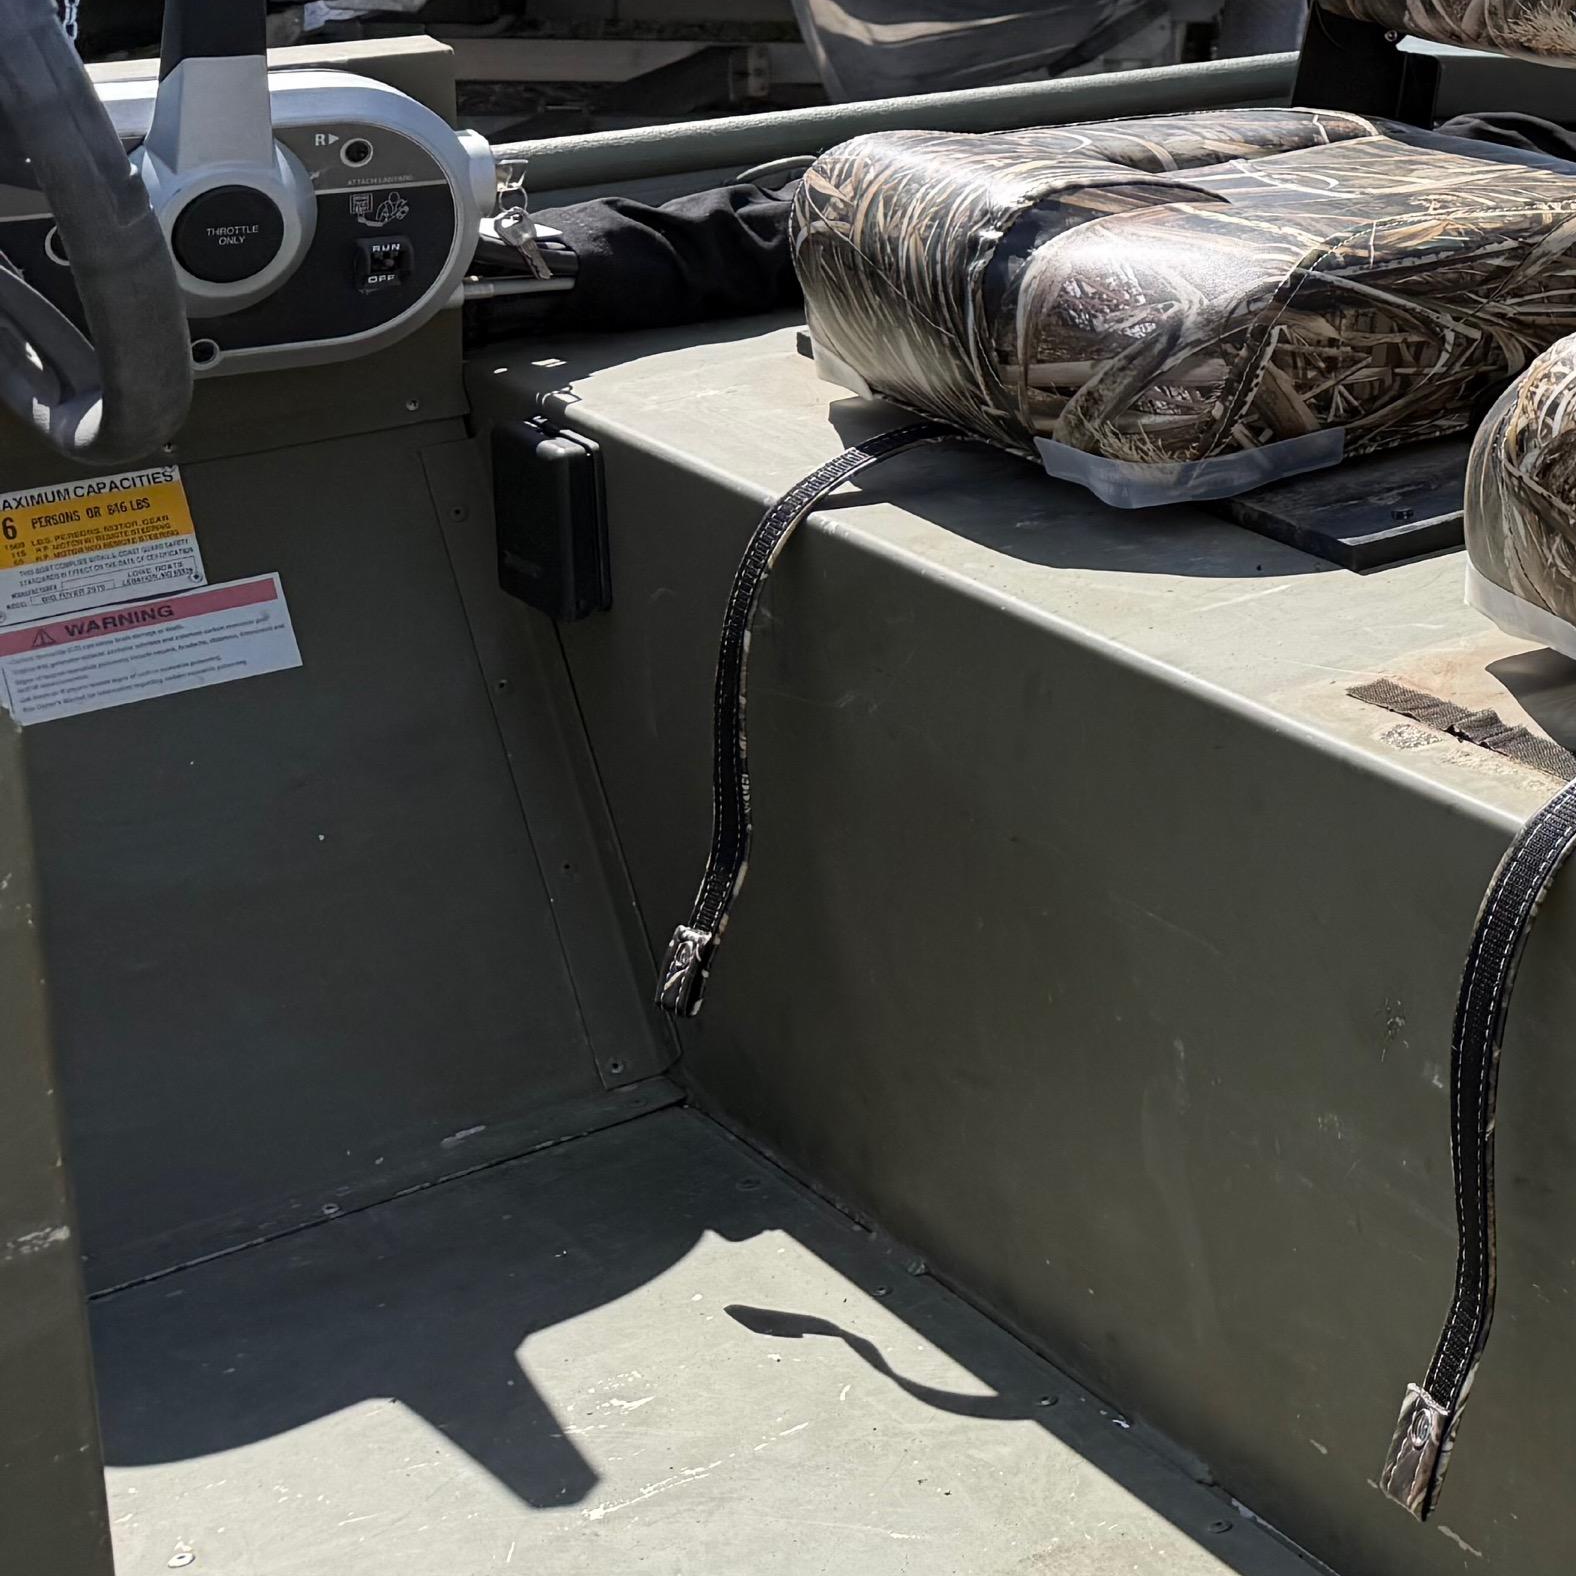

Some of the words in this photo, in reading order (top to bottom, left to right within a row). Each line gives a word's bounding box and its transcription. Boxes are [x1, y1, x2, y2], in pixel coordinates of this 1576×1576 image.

[315, 133, 326, 146] R
[206, 224, 259, 237] THROTTLE
[218, 234, 245, 246] ONLY
[372, 243, 401, 252] RUN
[367, 273, 396, 284] OFF
[1, 488, 70, 511] AXIMUM
[73, 470, 174, 498] CAPACITIES
[2, 516, 18, 540] 6
[31, 510, 81, 530] PERSONS
[86, 506, 102, 519] OR
[131, 498, 151, 512] LBS
[64, 604, 175, 637] WARNING
